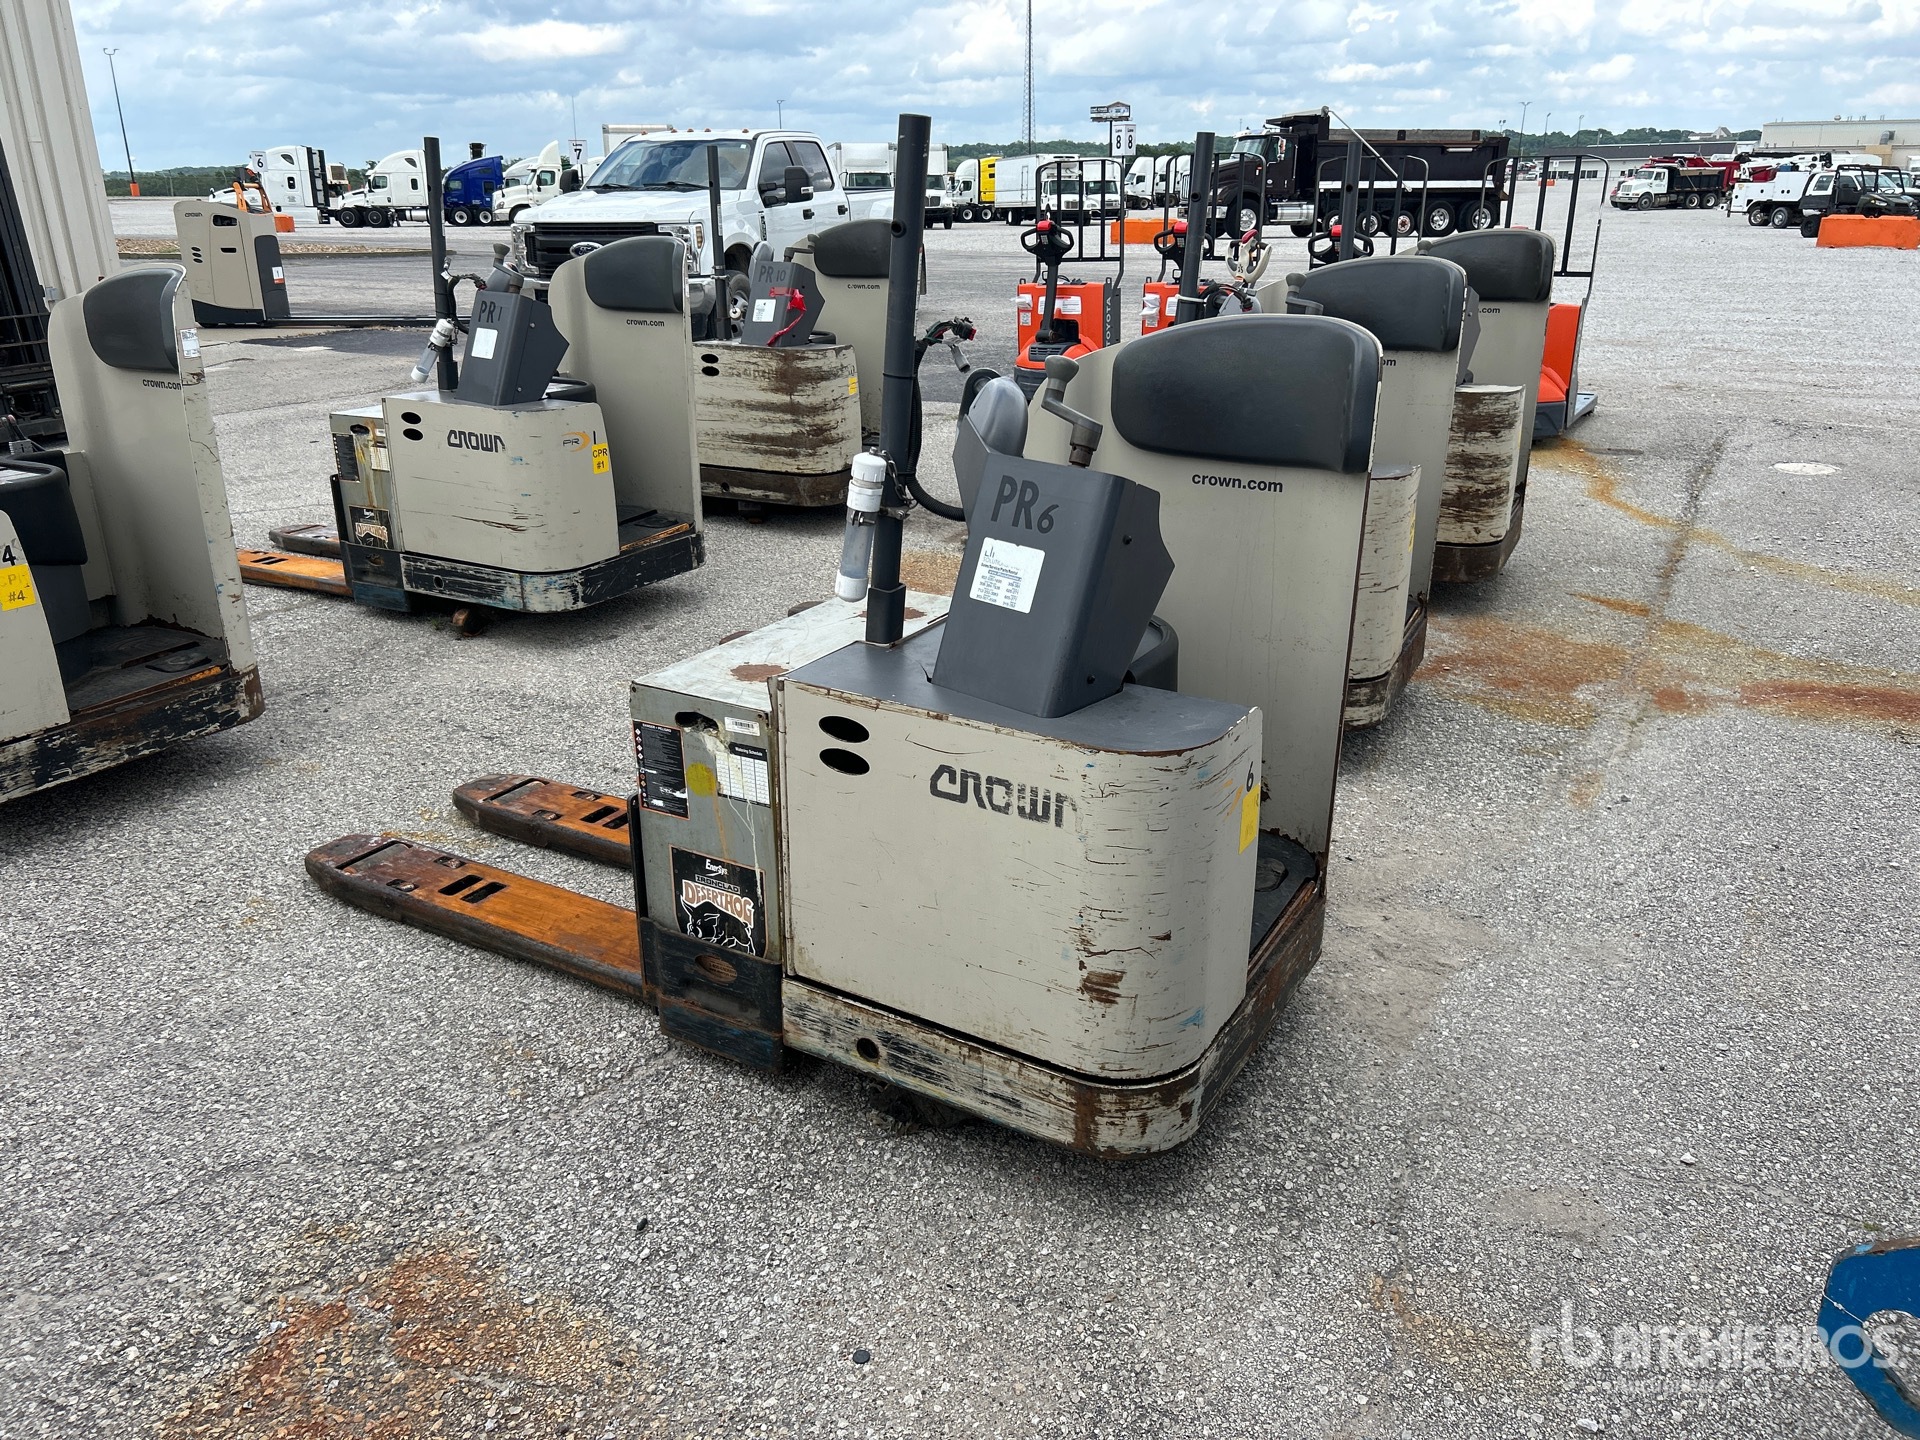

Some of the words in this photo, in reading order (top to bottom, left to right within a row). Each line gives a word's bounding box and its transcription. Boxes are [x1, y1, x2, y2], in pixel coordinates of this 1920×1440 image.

[1116, 134, 1122, 149] 8
[1128, 134, 1133, 149] 8
[574, 149, 582, 160] 7
[257, 158, 264, 168] 6
[758, 265, 774, 283] PR
[626, 319, 665, 327] crown.com
[562, 438, 580, 447] PR
[592, 448, 608, 459] CPR
[596, 460, 605, 470] #1
[1191, 473, 1284, 493] crown.com
[990, 475, 1059, 534] PR6
[2, 545, 17, 567] 4
[8, 589, 26, 602] #4
[1246, 760, 1254, 792] 6
[705, 858, 728, 875] EnerSys
[696, 874, 739, 893] IRONCLAD
[682, 879, 755, 929] DESERTHOG
